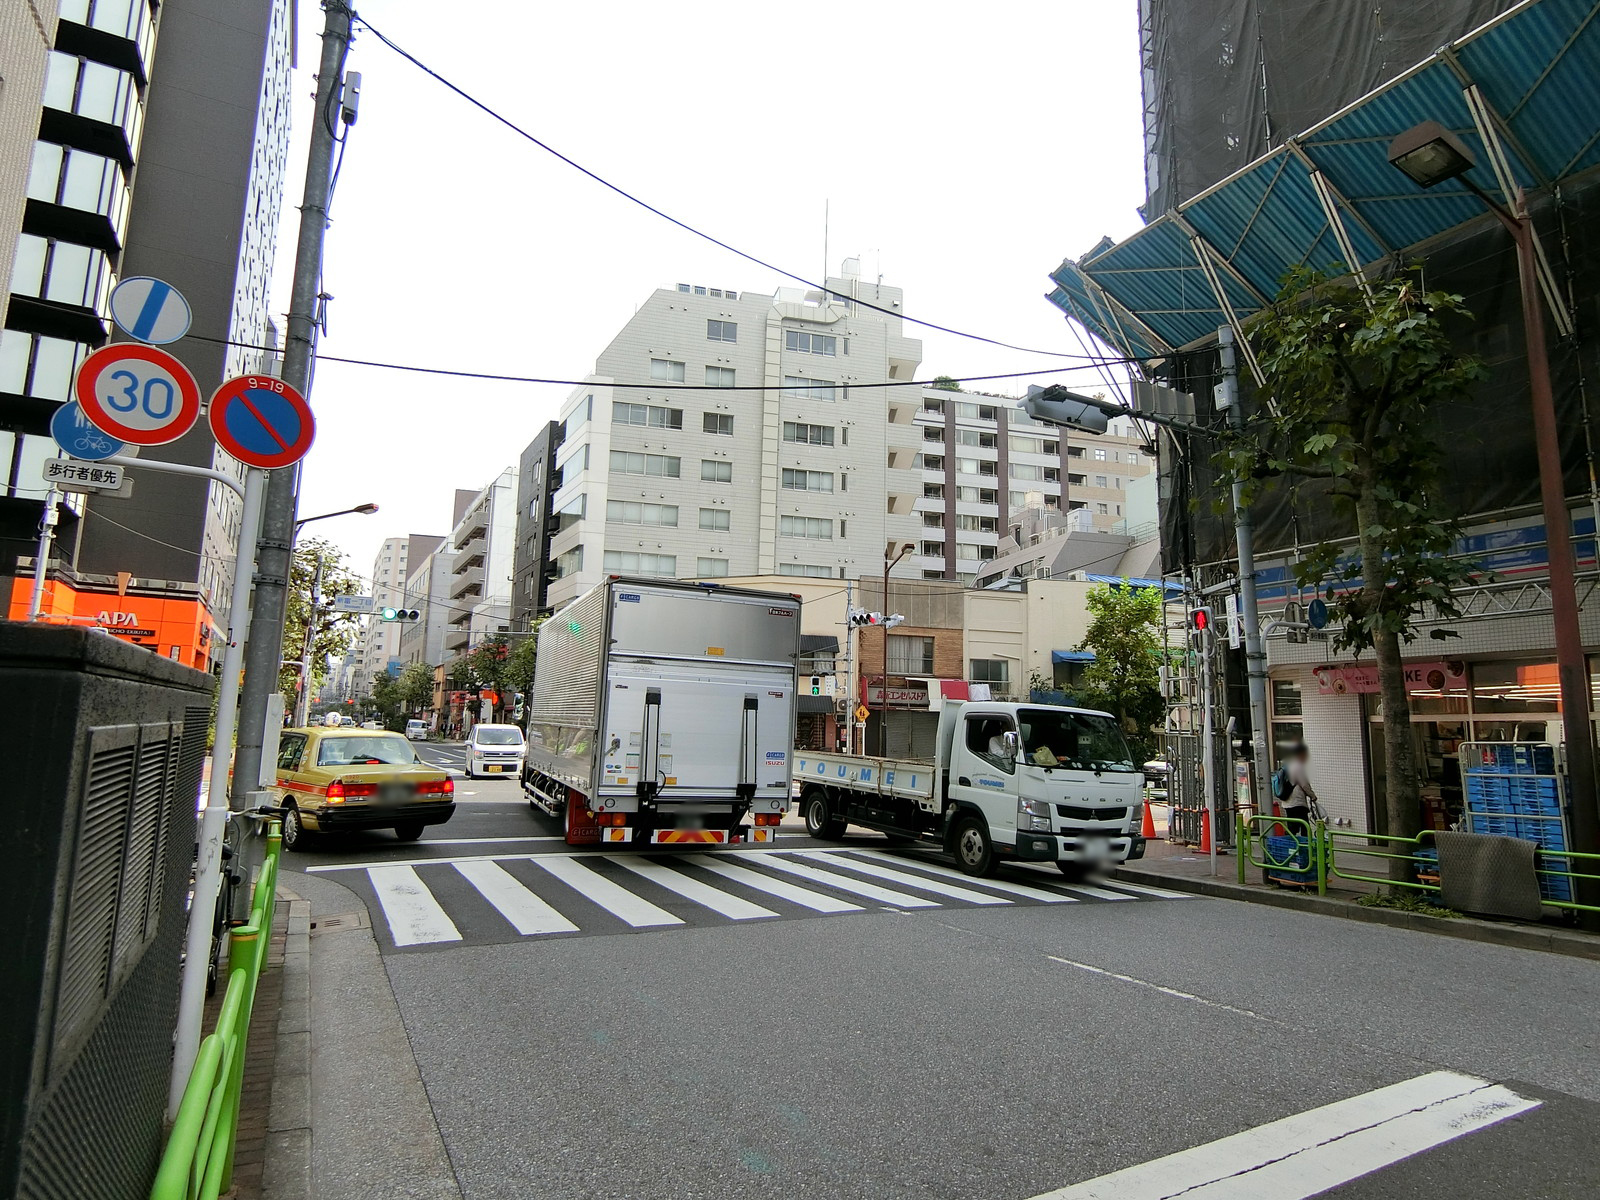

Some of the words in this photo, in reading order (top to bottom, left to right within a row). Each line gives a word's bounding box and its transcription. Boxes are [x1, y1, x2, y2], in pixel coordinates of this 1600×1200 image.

[248, 377, 285, 394] 9-19
[107, 369, 175, 420] 30
[49, 463, 118, 484] 歩行者優先
[98, 610, 139, 627] APA
[1063, 795, 1123, 803] FUSO
